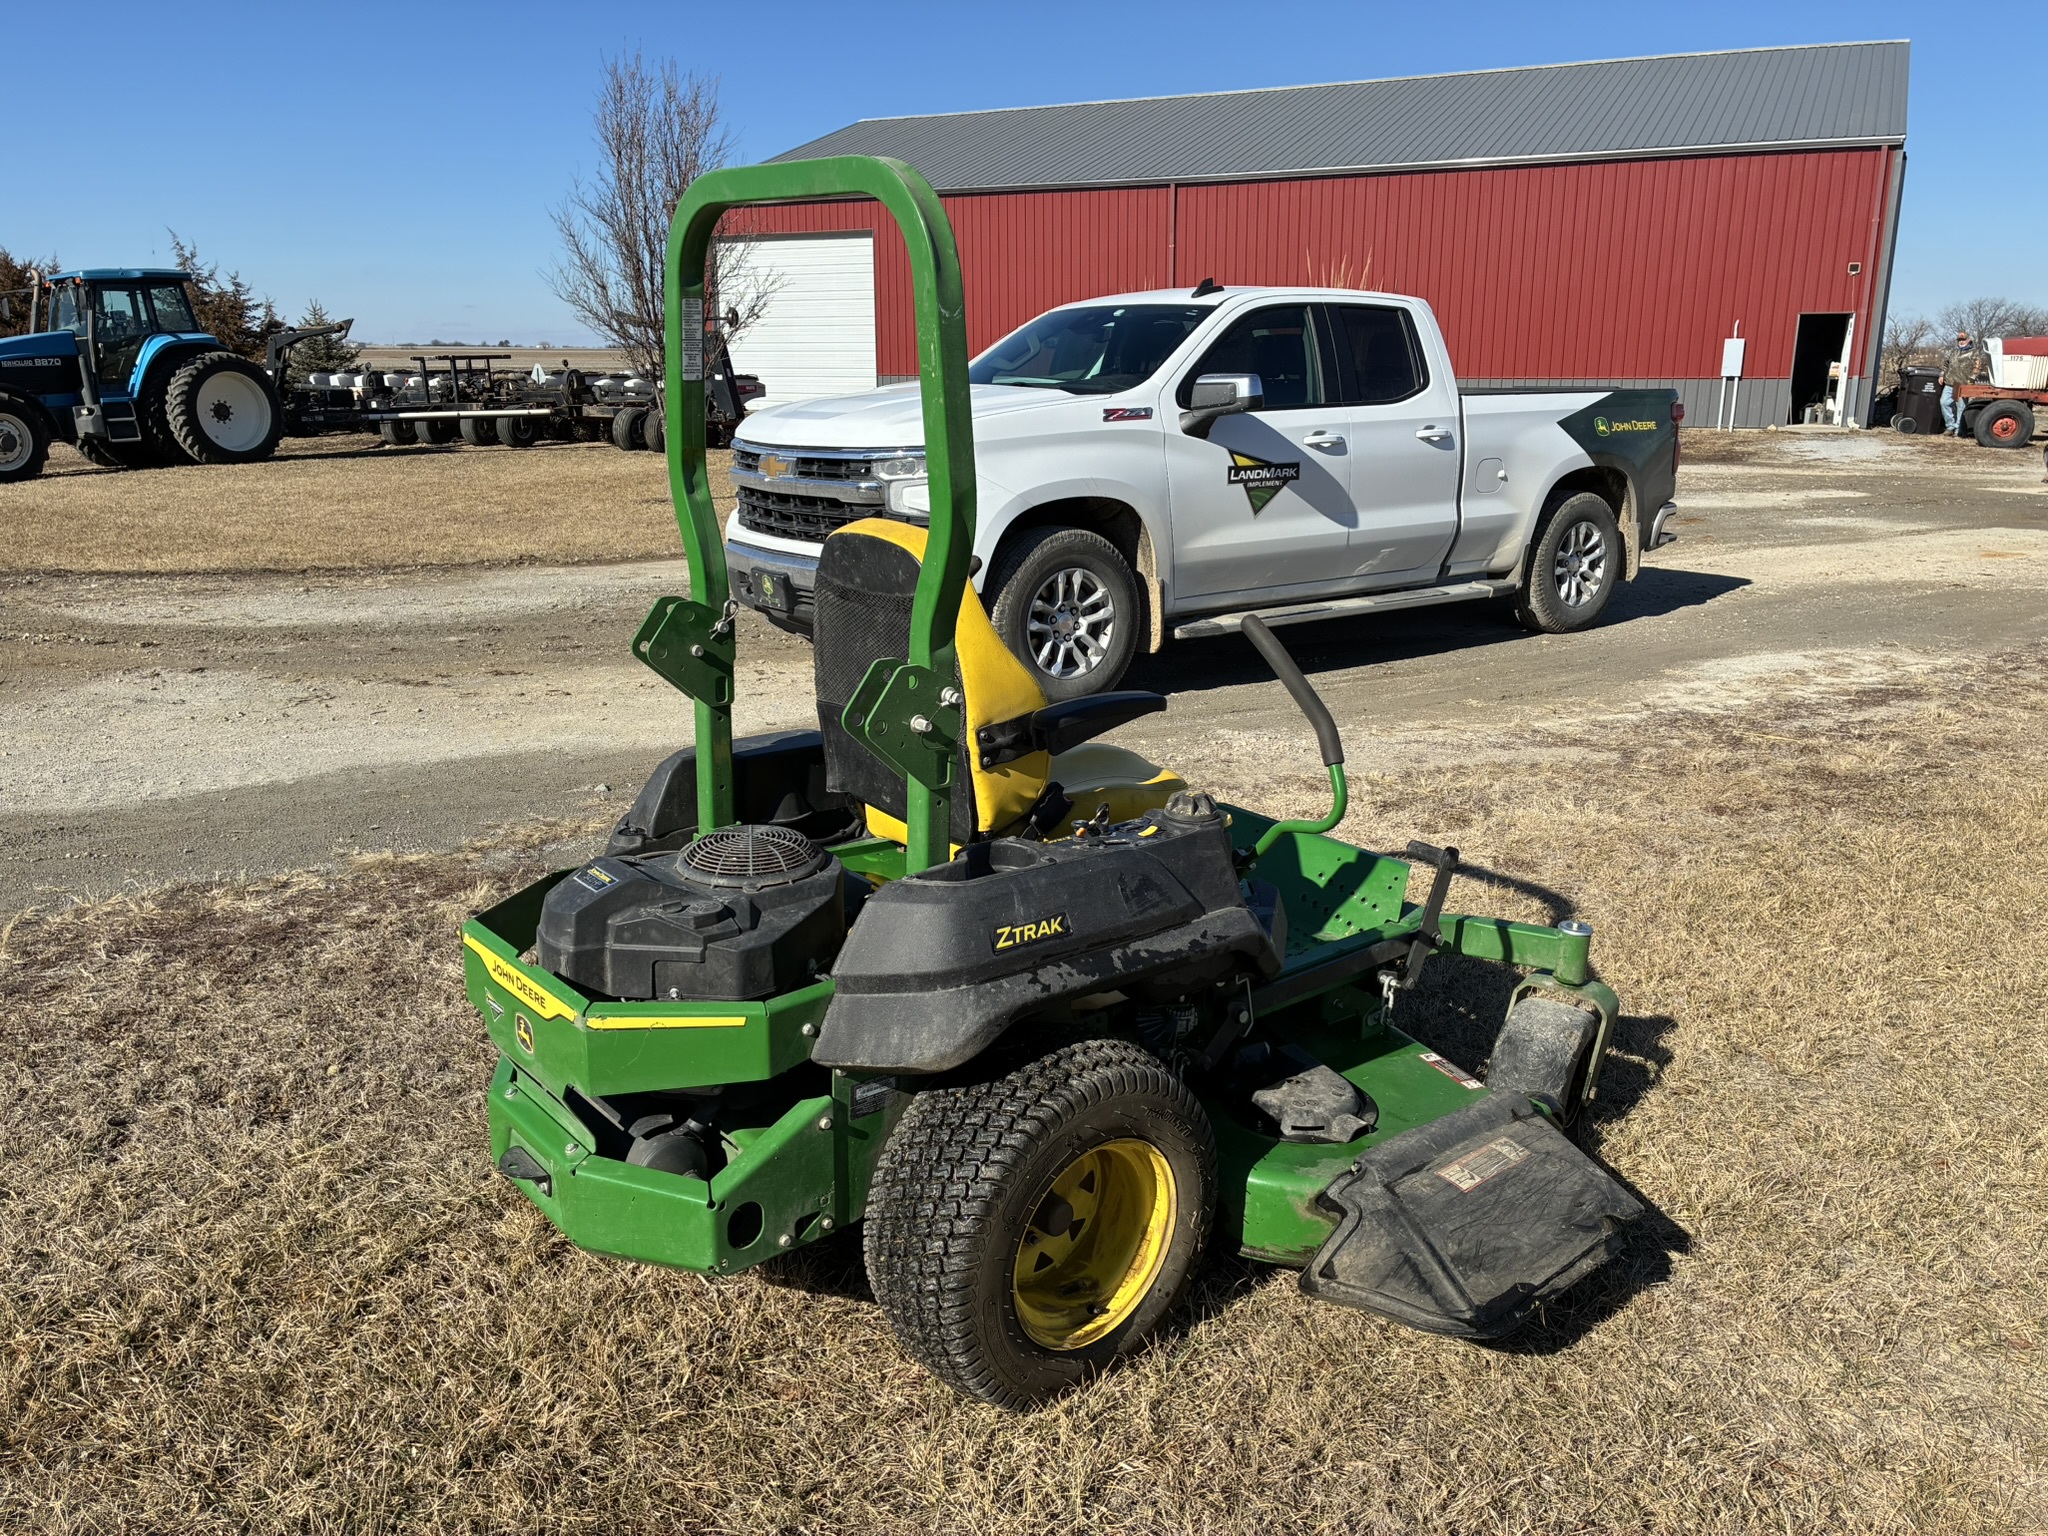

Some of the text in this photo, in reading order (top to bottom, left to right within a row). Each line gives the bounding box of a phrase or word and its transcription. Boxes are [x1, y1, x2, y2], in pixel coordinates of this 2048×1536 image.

[34, 358, 61, 366] 8870
[1611, 420, 1657, 432] JOHN DEERE
[996, 916, 1064, 949] ZTRAK
[492, 959, 515, 987] JOHN
[516, 975, 547, 1010] DEERE
